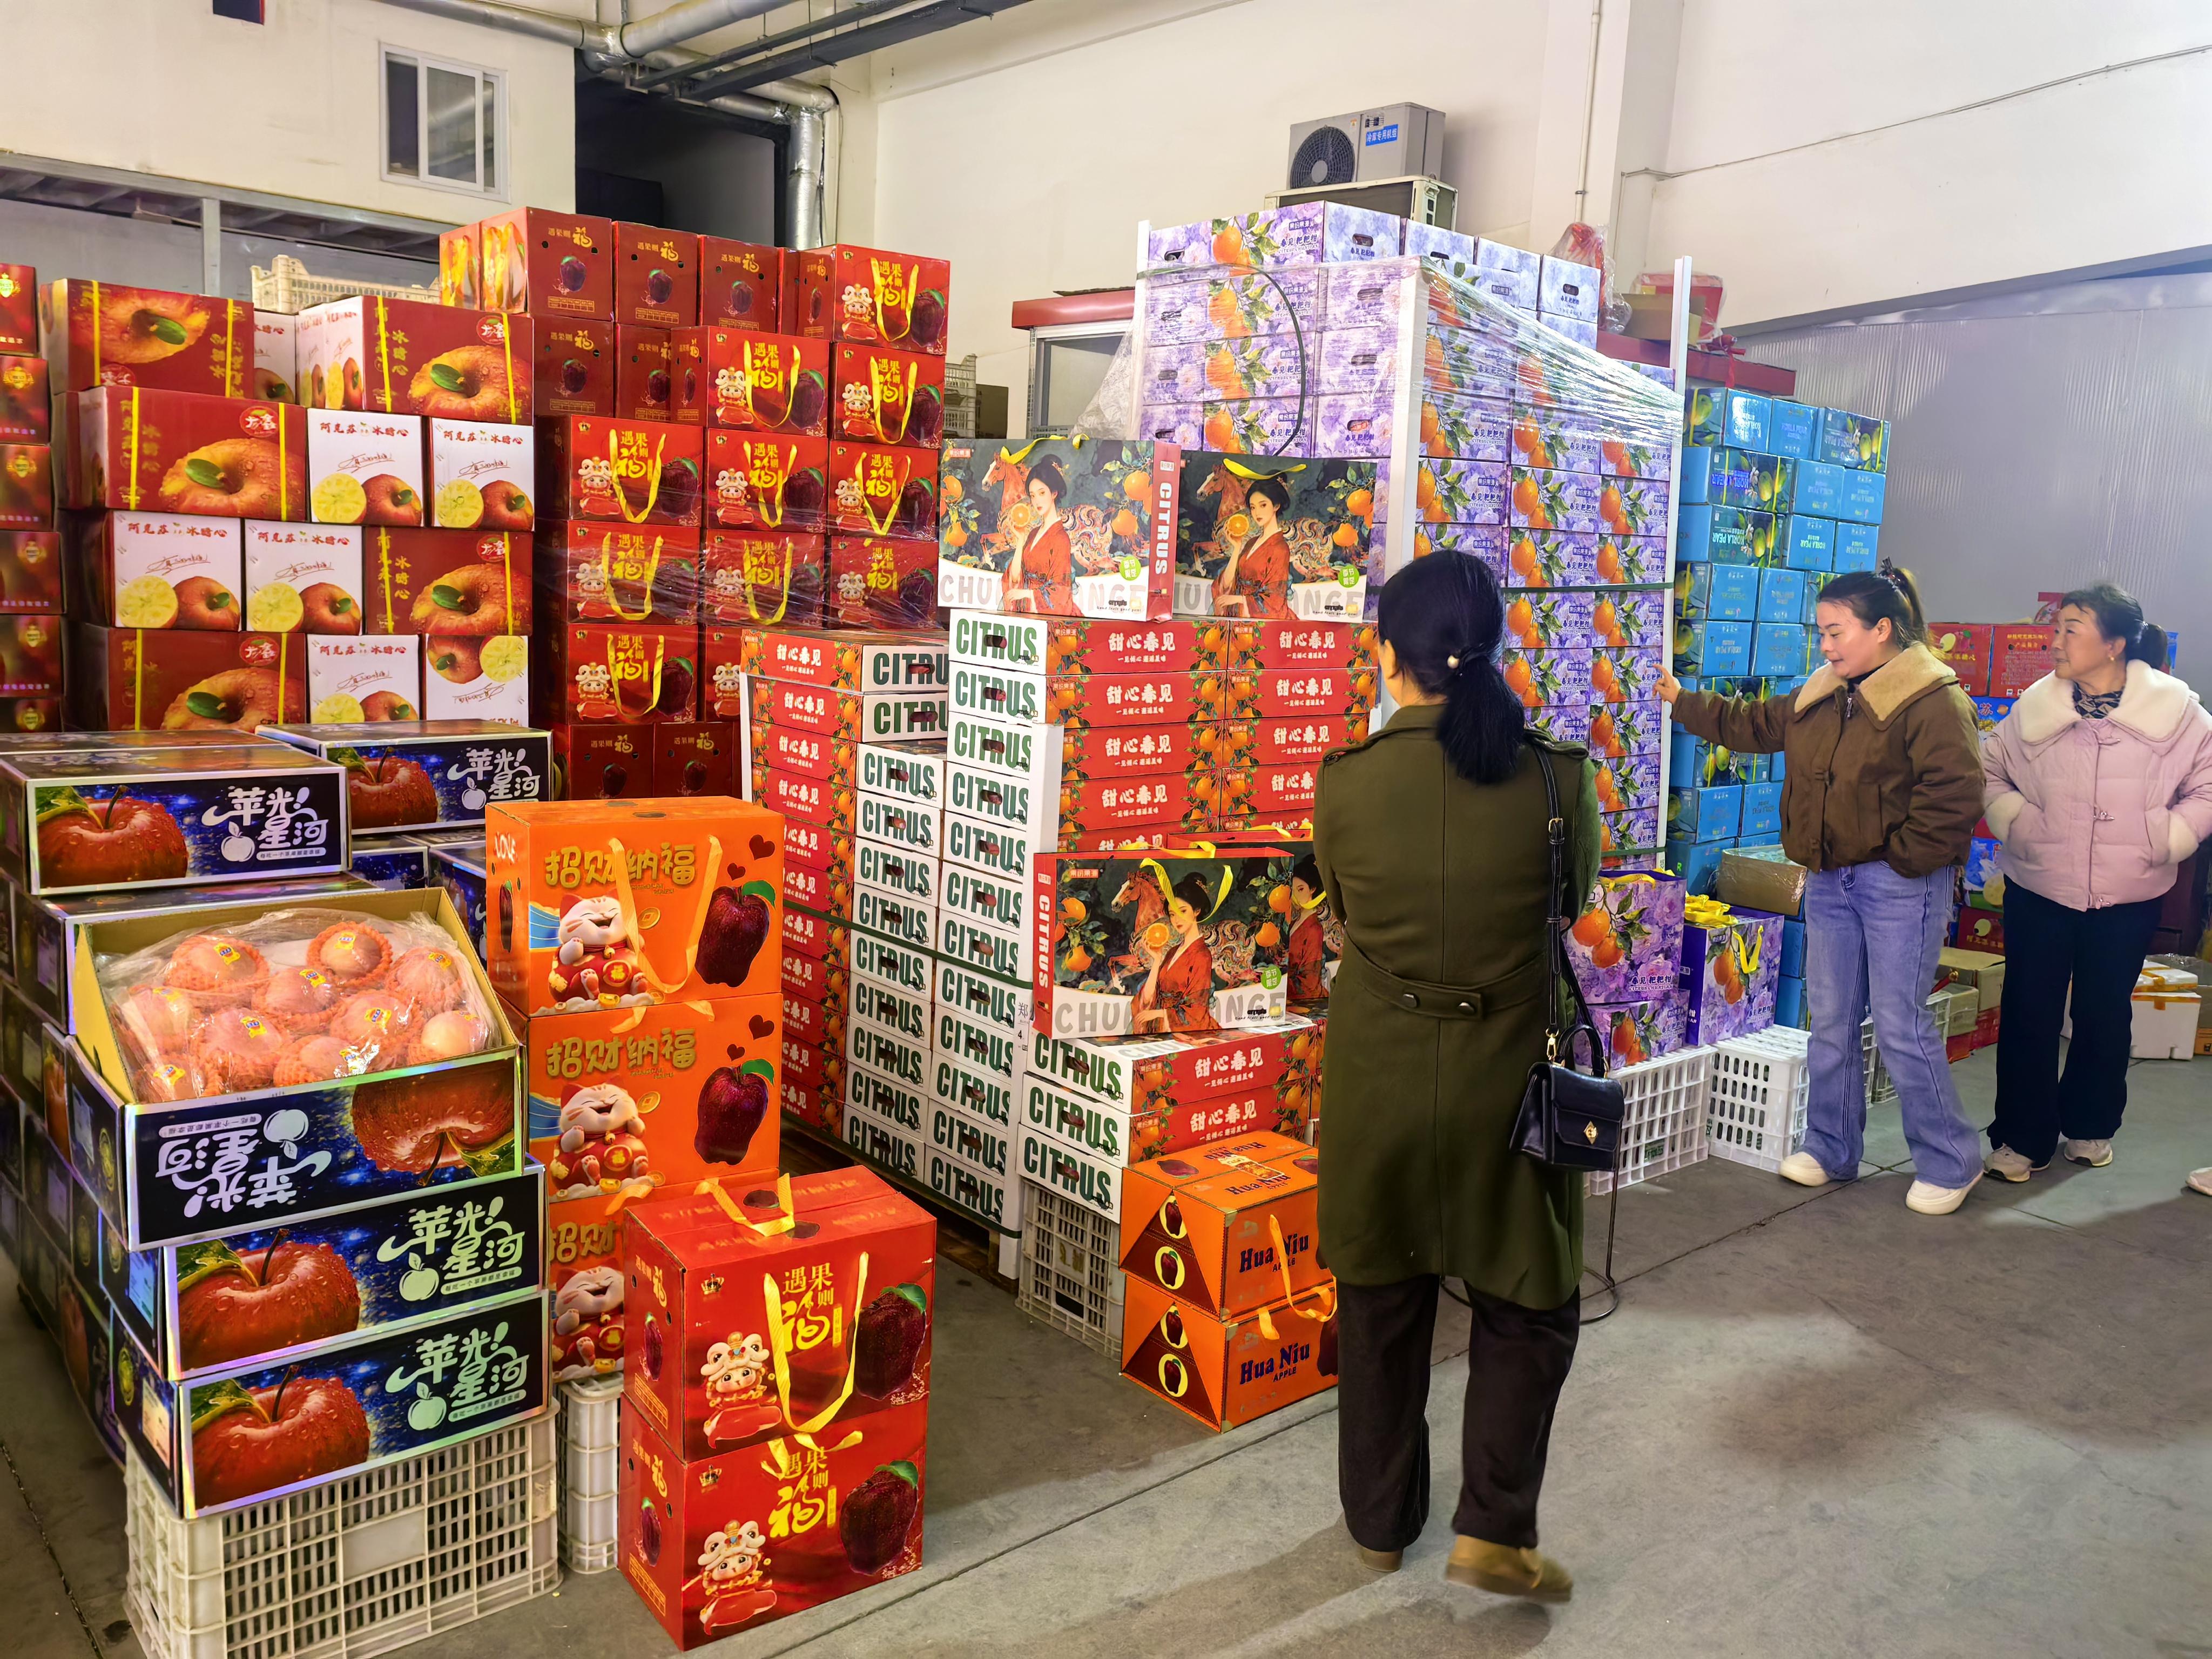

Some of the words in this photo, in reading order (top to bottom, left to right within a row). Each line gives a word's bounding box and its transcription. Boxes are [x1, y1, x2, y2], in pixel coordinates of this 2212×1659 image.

[1155, 482, 1172, 575] CITRUS
[777, 643, 821, 666] 甜心春见
[956, 618, 1037, 664] CITRUS
[1108, 631, 1176, 652] 甜心春见
[1279, 631, 1336, 649] 甜心春见
[873, 652, 949, 685] CITRU
[785, 692, 825, 716] 甜心春见
[955, 671, 1036, 718] CITRUS
[1106, 683, 1174, 704] 甜心春见
[1276, 678, 1333, 697] 甜心春见
[873, 700, 948, 734] CITRU
[779, 735, 819, 760] 甜心春见
[1105, 734, 1172, 757] 甜心春见
[1273, 725, 1330, 745] 甜心春见
[778, 779, 819, 805] 甜心春见
[864, 752, 935, 799] CITRUS
[1271, 771, 1313, 792] 甜心春
[1102, 784, 1168, 808] 甜心春见
[862, 799, 931, 848] CITRUS
[860, 846, 929, 896] CITRUS
[859, 892, 928, 945] CITRUS
[1038, 894, 1050, 989] CITRUS
[857, 937, 925, 992] CITRUS
[855, 982, 923, 1038] CITRUS
[546, 1028, 697, 1079] 招财纳福
[853, 1026, 922, 1084] CITRUS
[1034, 1031, 1122, 1100] CITRUS
[1195, 1047, 1264, 1079] 甜心春见
[852, 1071, 920, 1131] CITRUS
[1190, 1100, 1257, 1132] 甜心春见
[1029, 1086, 1118, 1157] CITRUS
[849, 1115, 917, 1177] CITRUS
[1024, 1136, 1111, 1209] CITRUS
[1224, 1179, 1256, 1195] Hua
[1239, 1245, 1273, 1273] Hua
[1240, 1360, 1274, 1385] Hua
[1279, 1343, 1310, 1367] Niu
[1273, 1366, 1297, 1382] APPLE
